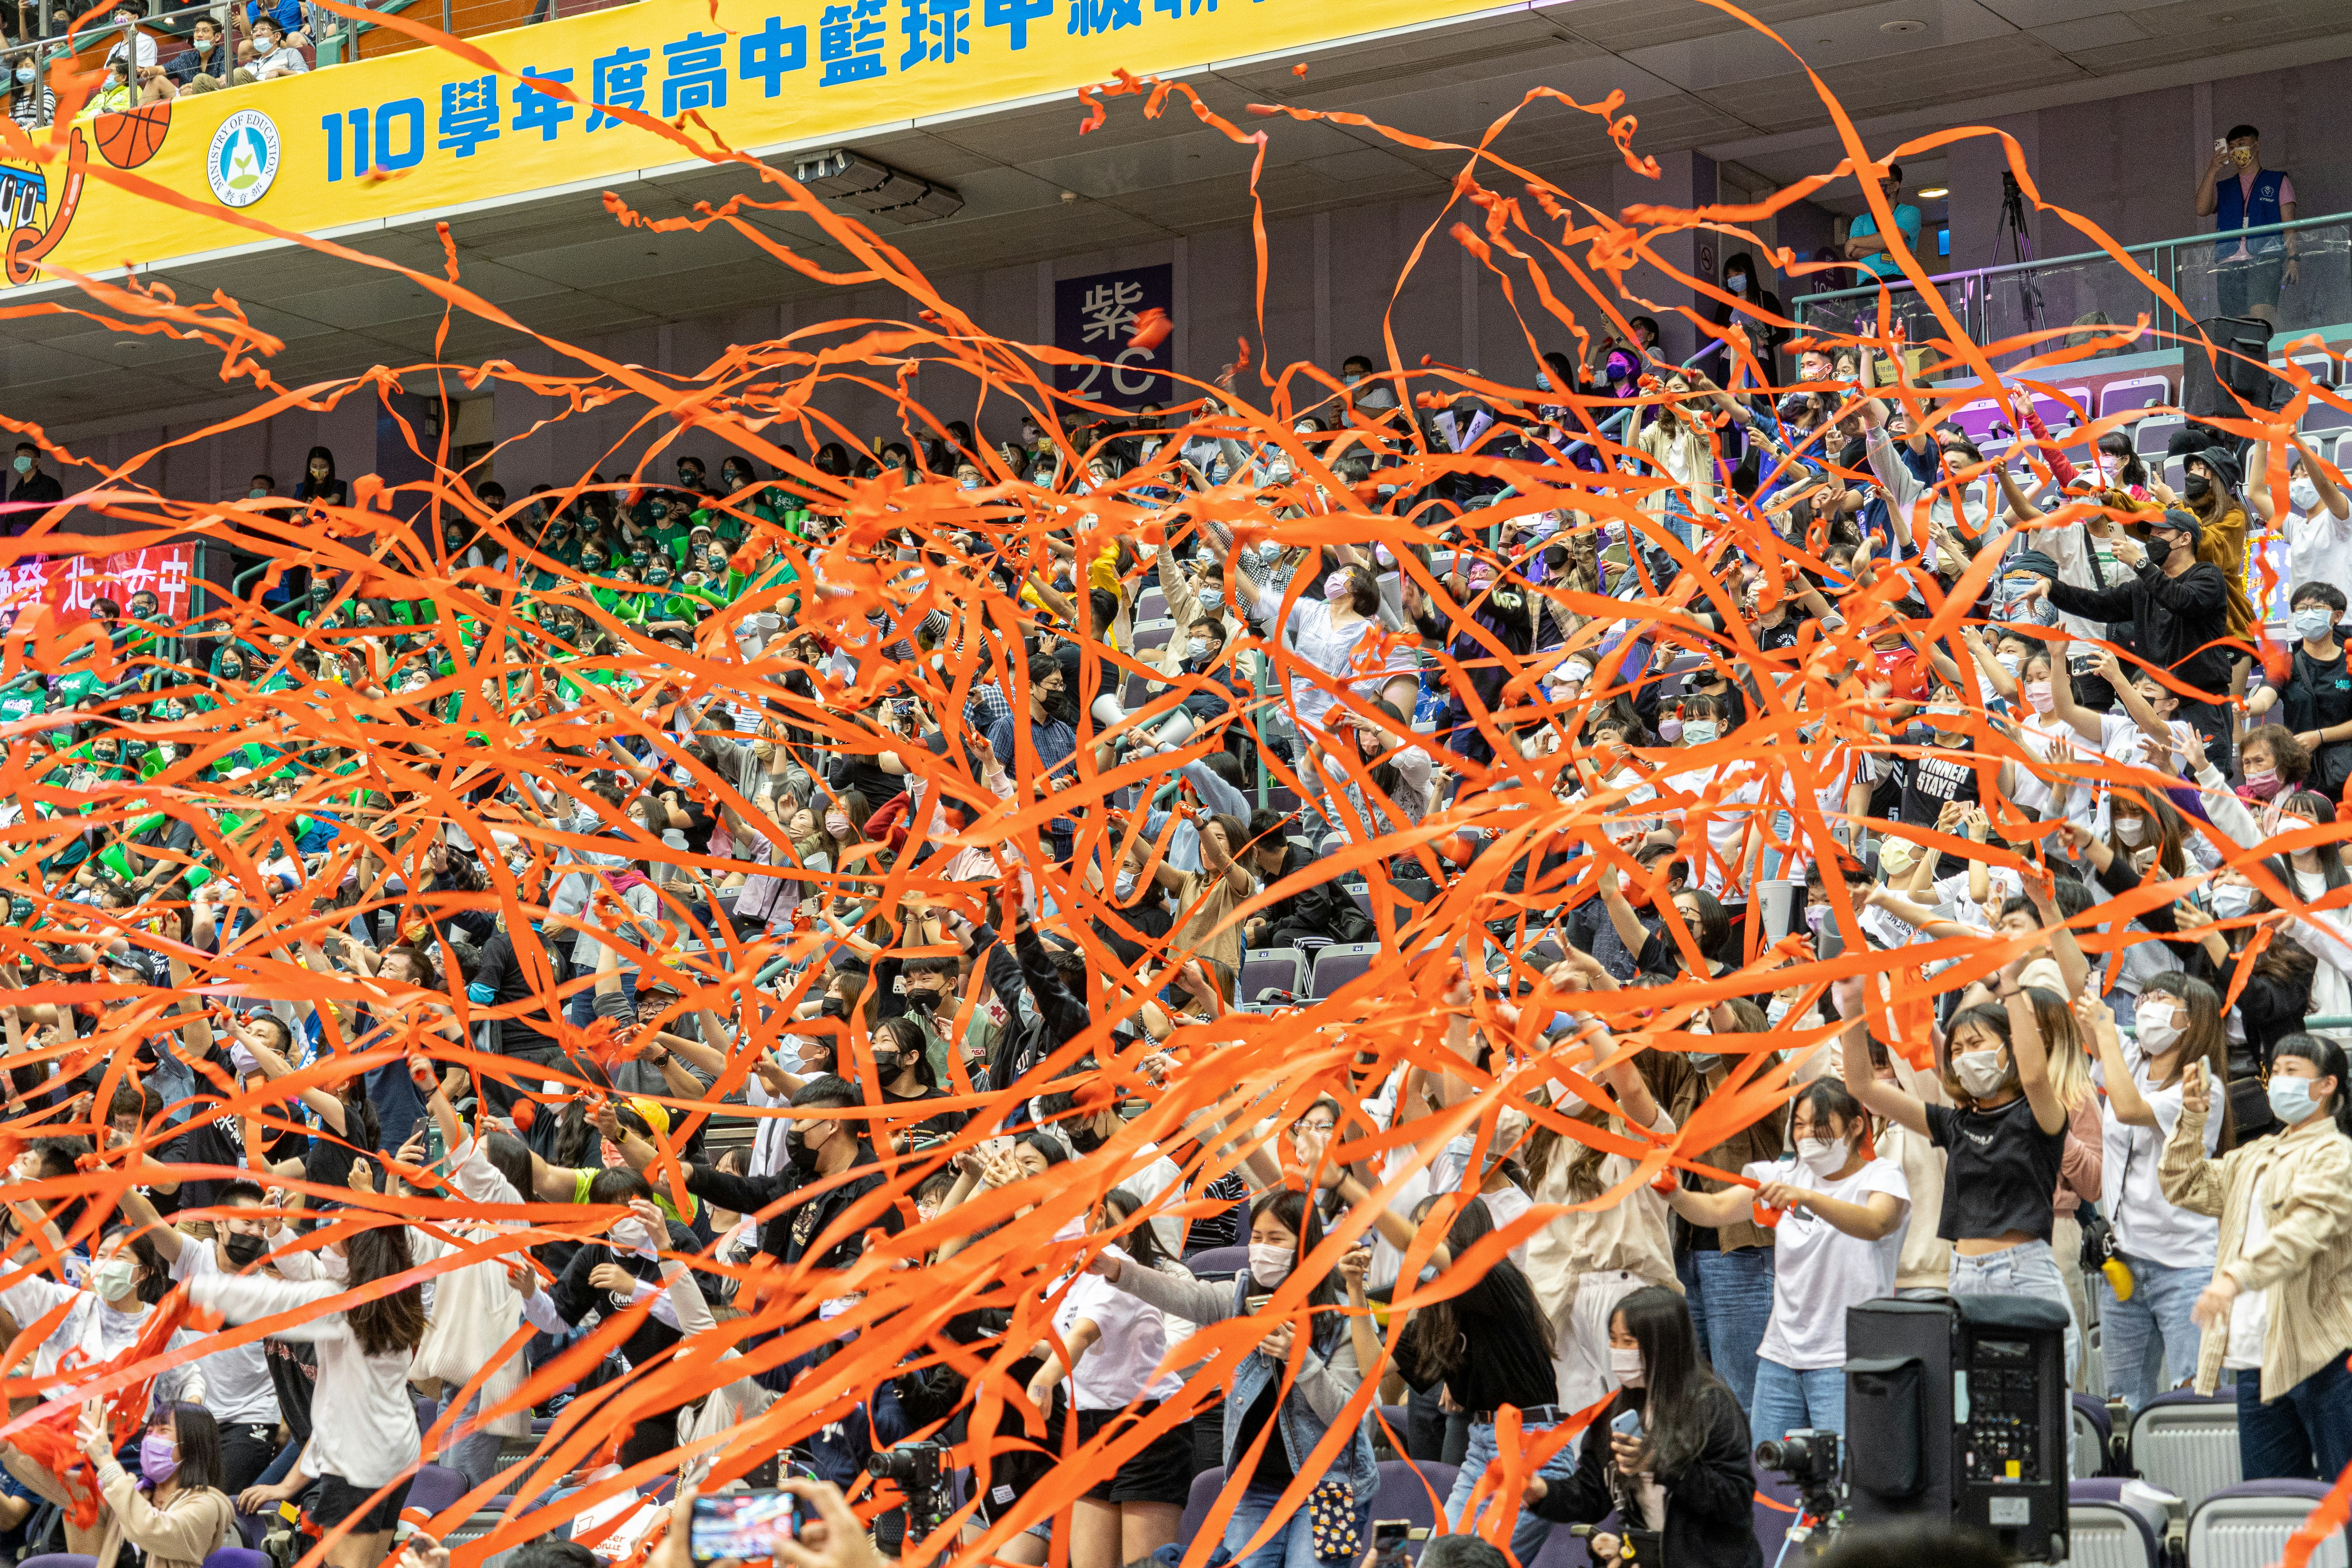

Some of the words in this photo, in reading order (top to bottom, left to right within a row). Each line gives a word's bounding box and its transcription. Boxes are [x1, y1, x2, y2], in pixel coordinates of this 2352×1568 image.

[211, 126, 228, 191] MINISTRY
[230, 115, 243, 129] OF
[247, 114, 276, 176] EDUCATION
[224, 183, 262, 204] 教育部
[1082, 281, 1143, 343] 紫
[1070, 347, 1156, 401] 2C
[62, 548, 187, 616] 北一女中
[1916, 771, 1957, 800] STAYS
[1918, 757, 1970, 784] WINNER
[1887, 807, 1898, 822] 5
